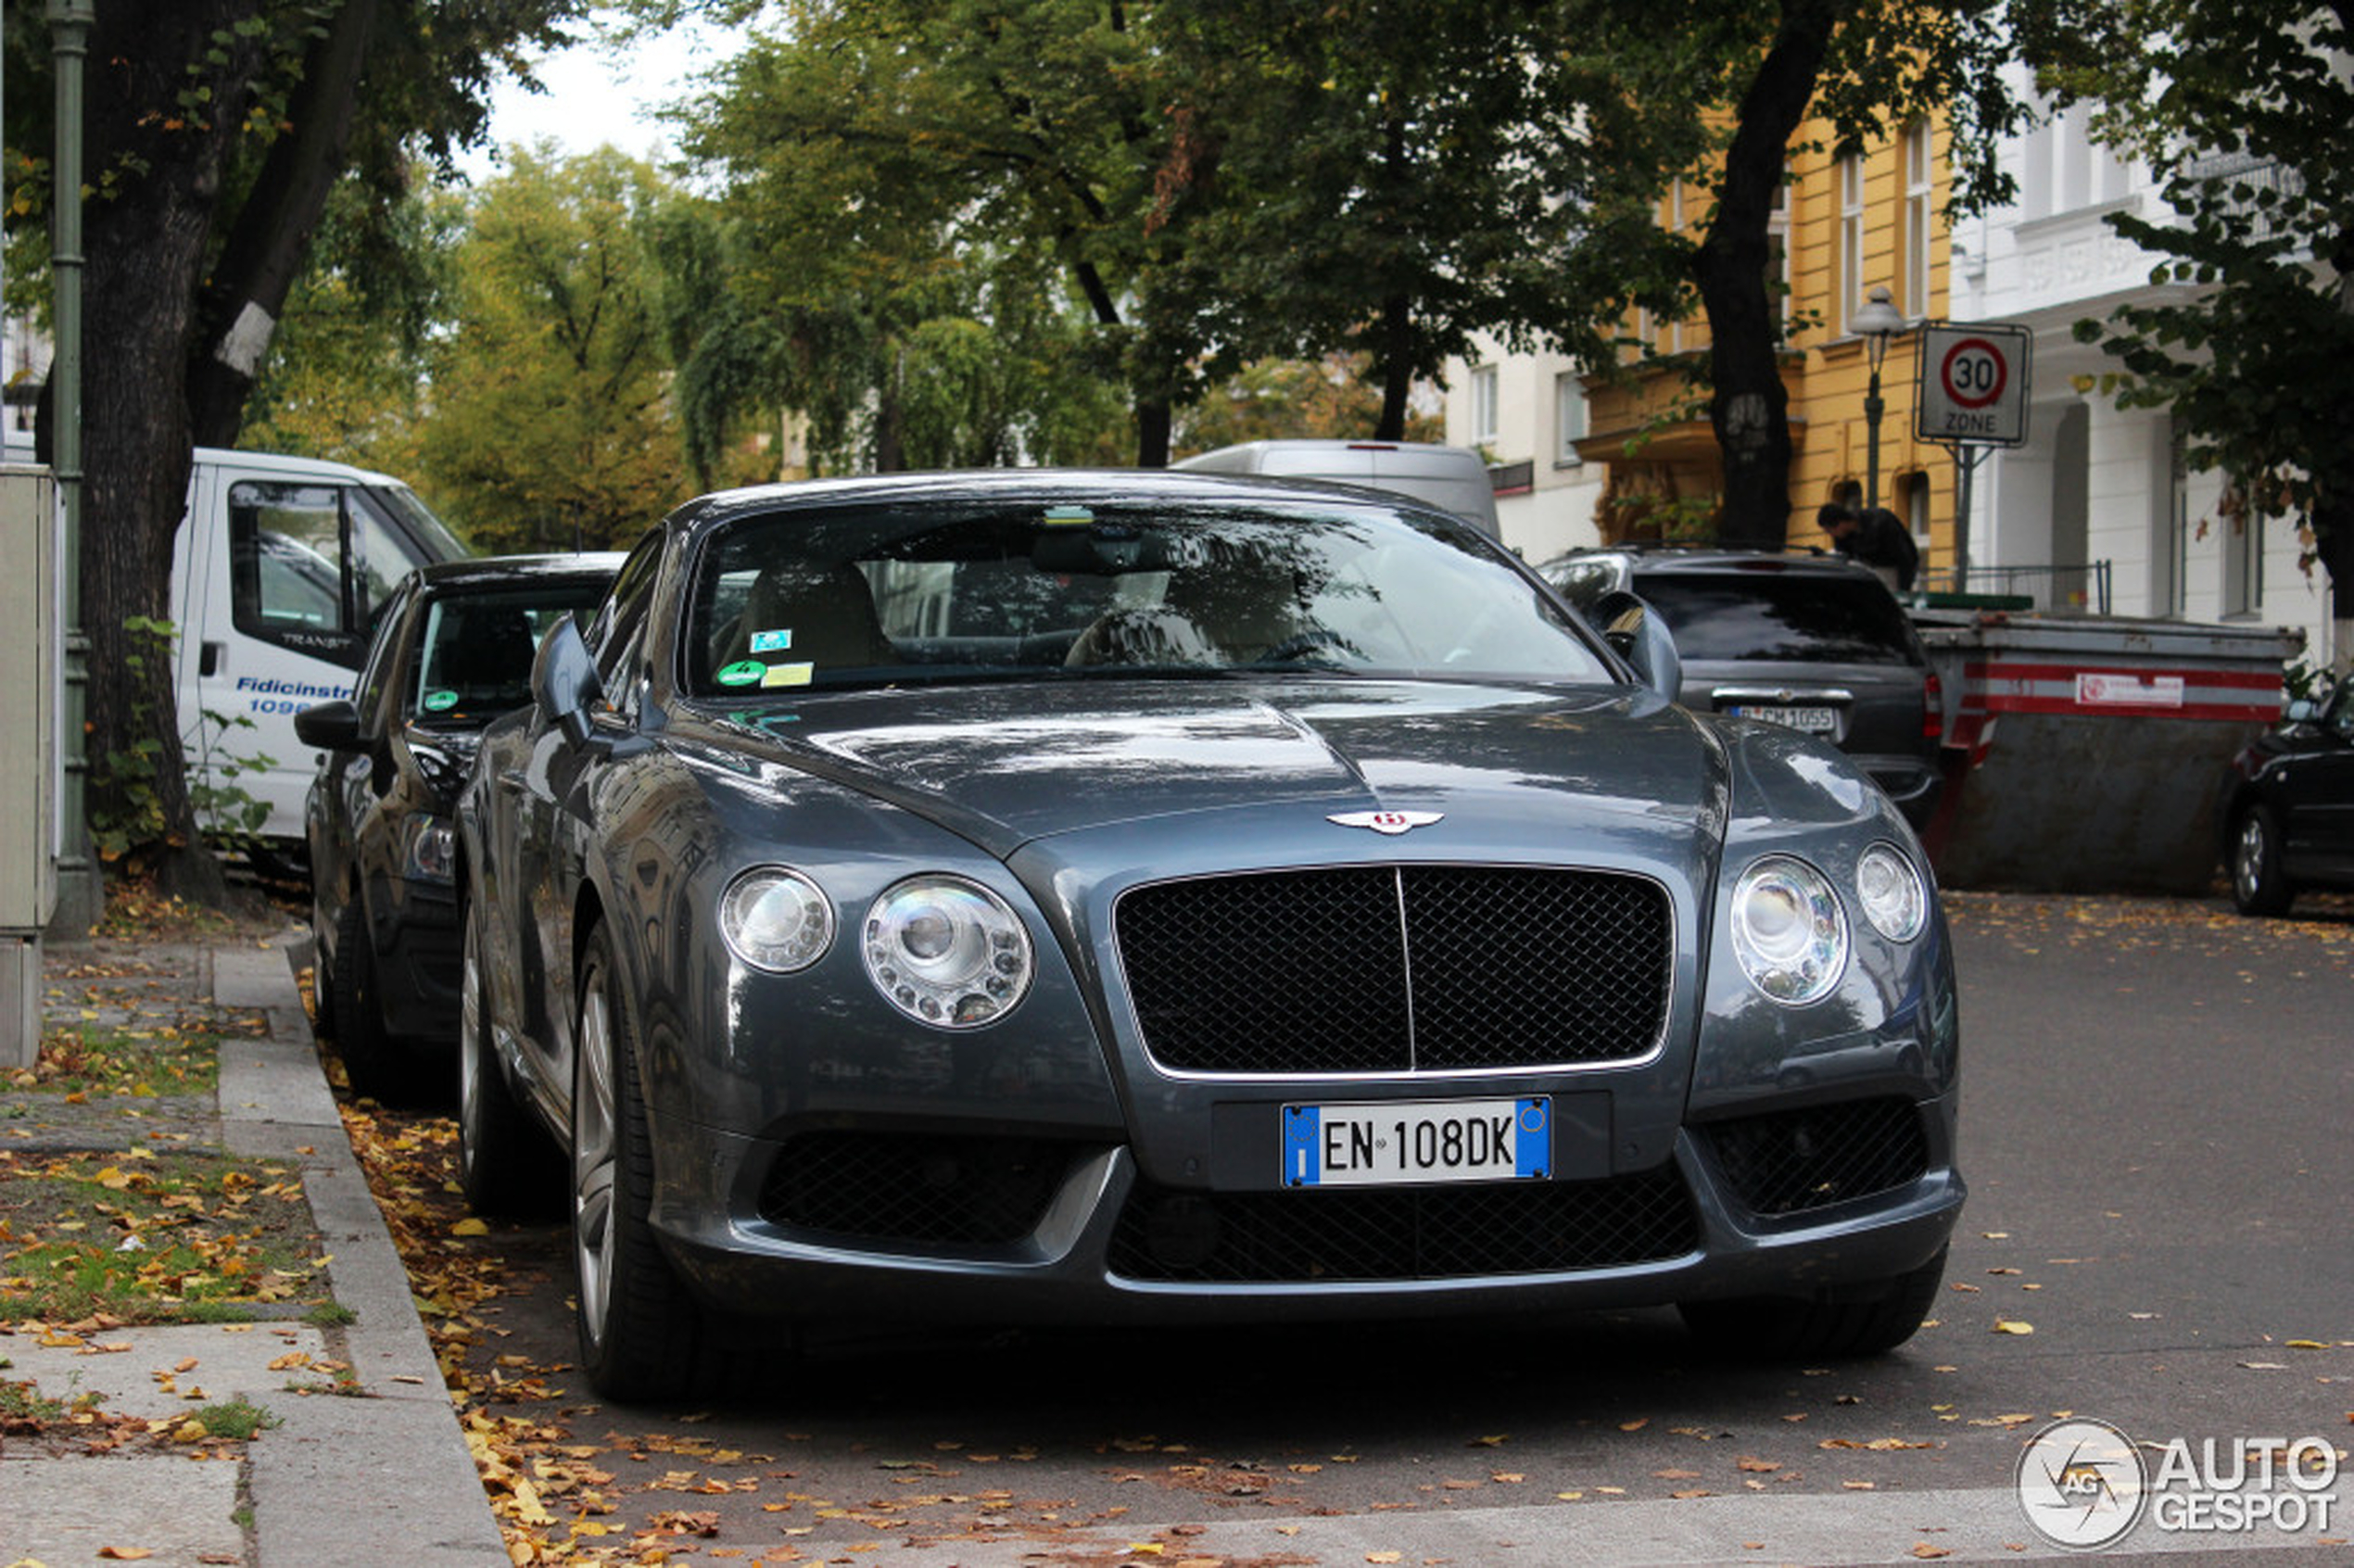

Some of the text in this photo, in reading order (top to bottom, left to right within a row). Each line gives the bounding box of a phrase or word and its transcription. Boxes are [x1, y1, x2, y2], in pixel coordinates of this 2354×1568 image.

[1955, 358, 1993, 392] 30
[1946, 412, 1996, 433] ZONE
[1324, 1116, 1514, 1170] EN 108DK
